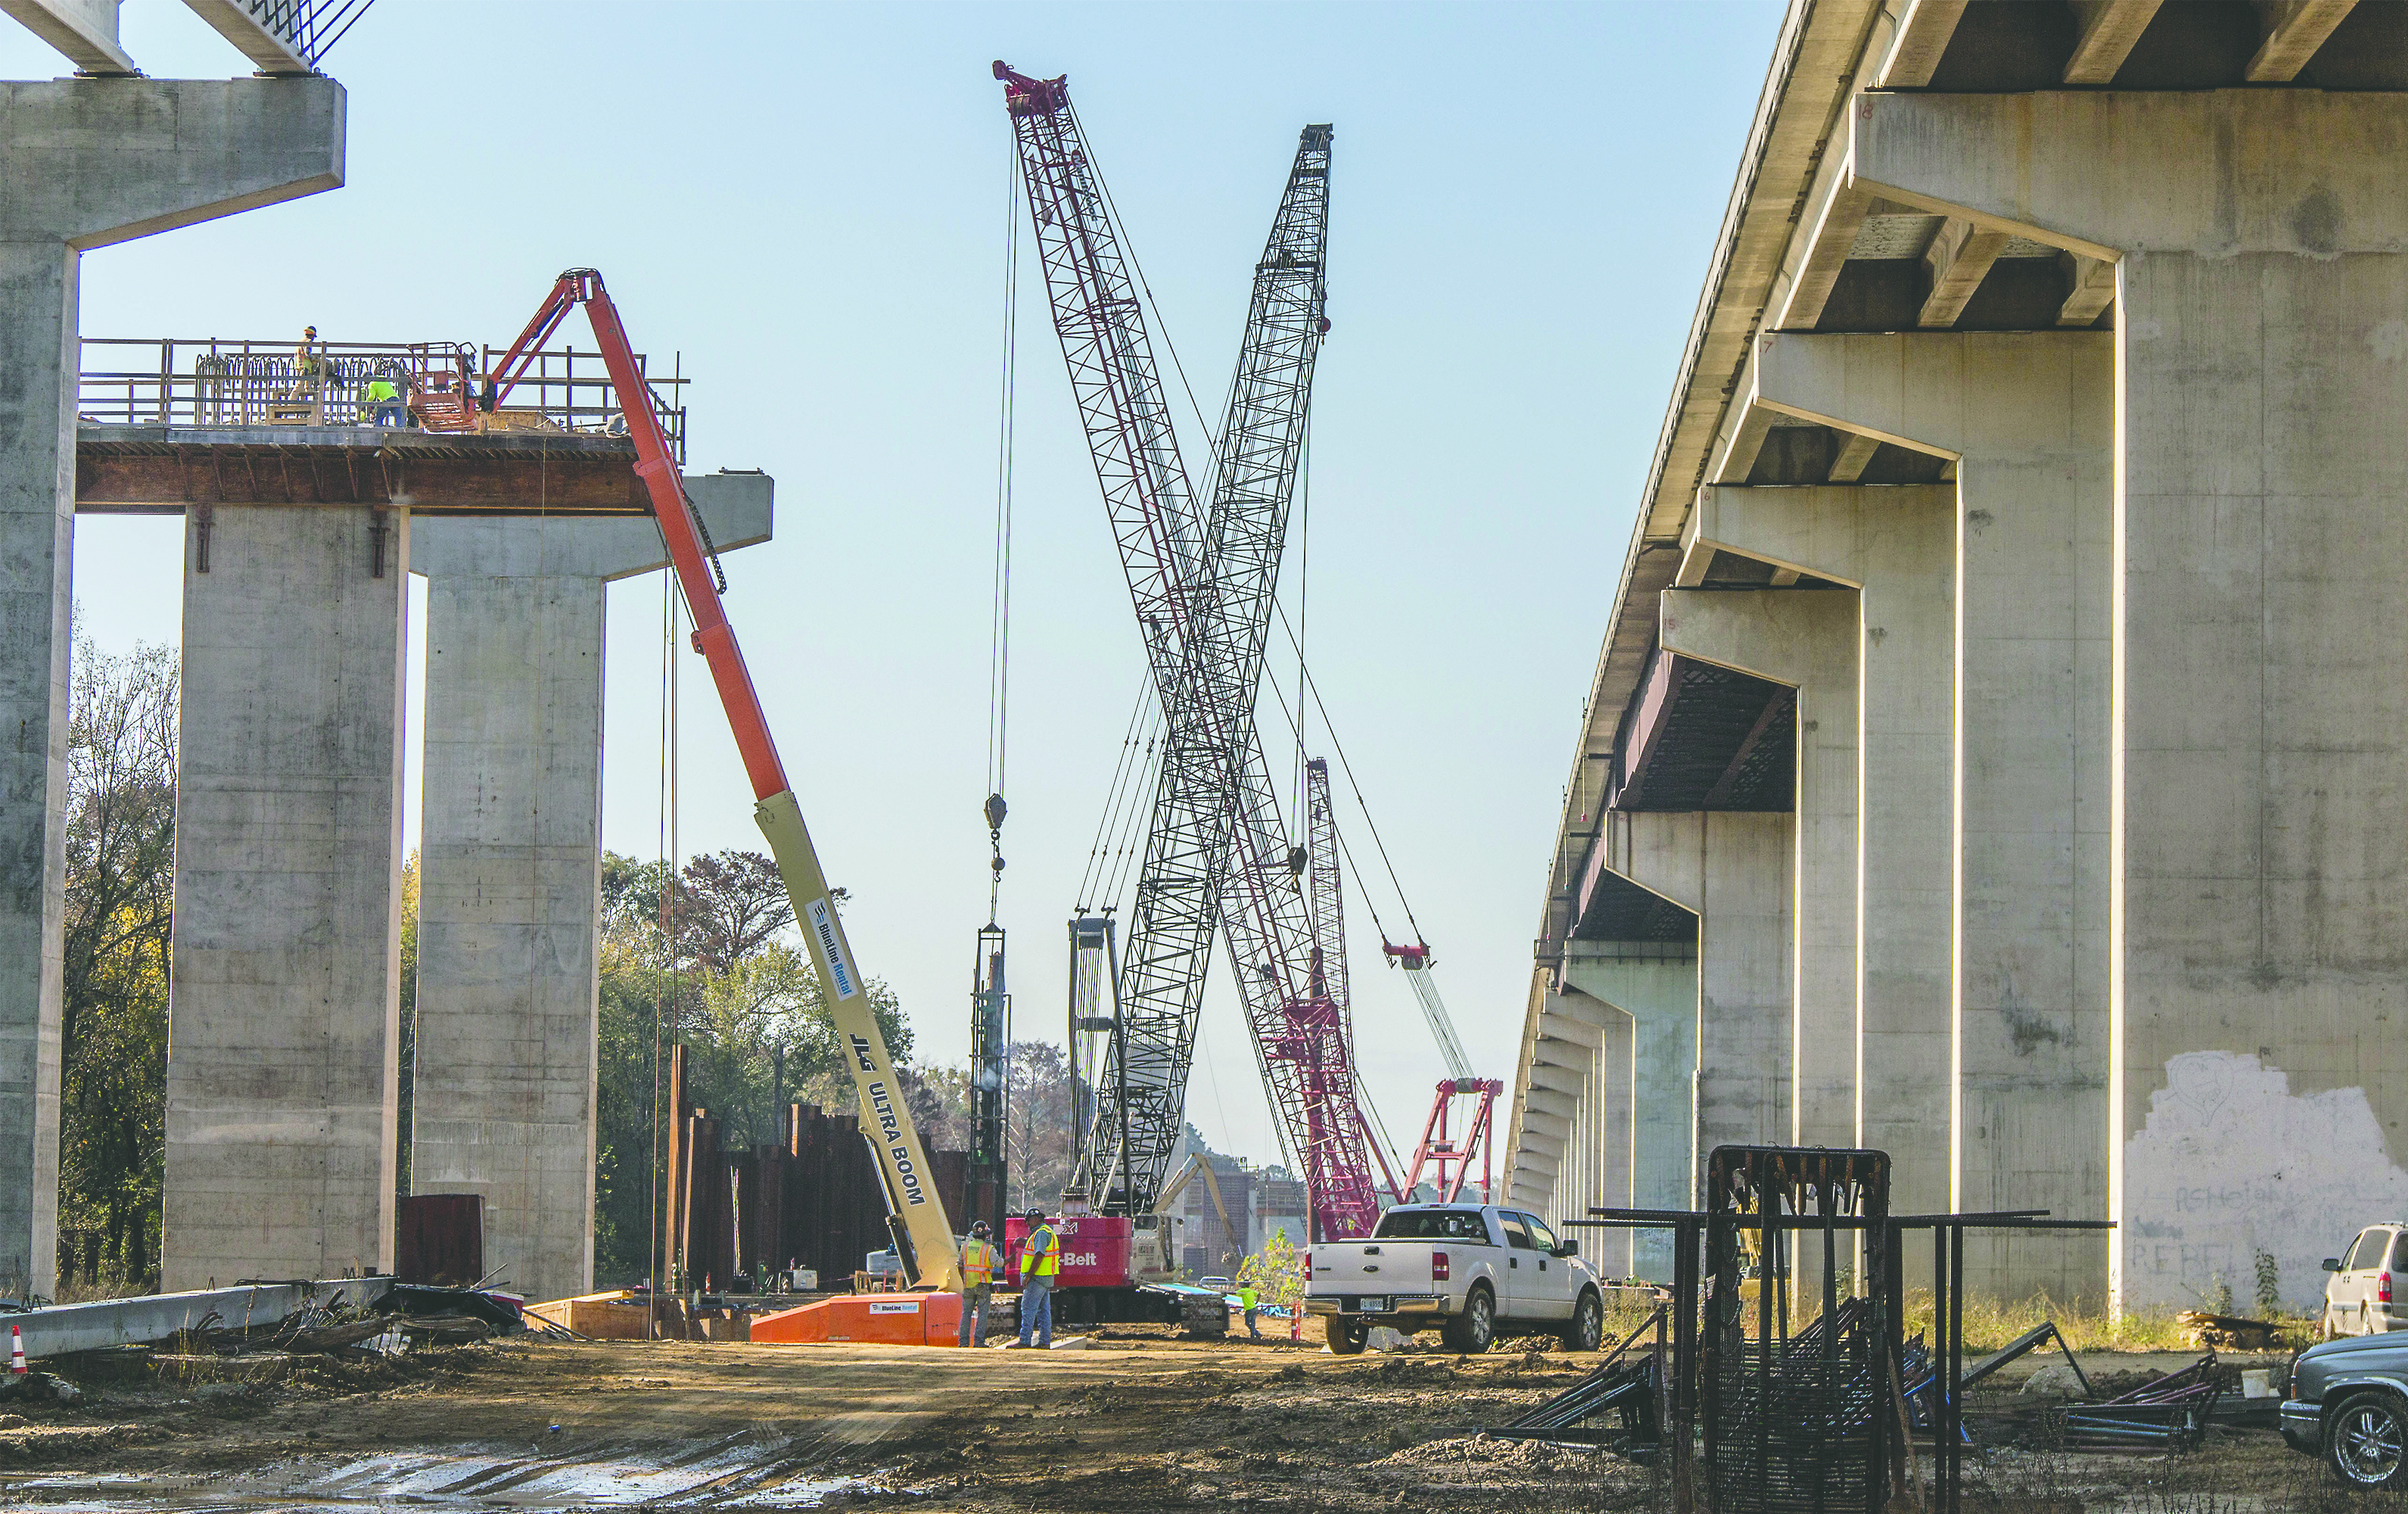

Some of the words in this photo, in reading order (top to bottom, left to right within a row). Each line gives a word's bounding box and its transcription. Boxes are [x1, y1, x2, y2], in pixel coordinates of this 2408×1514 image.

[1072, 154, 1098, 222] Manitowoc
[818, 923, 839, 964] BlueLine
[833, 963, 852, 995] Rental
[848, 1033, 878, 1073] JLG
[868, 1081, 902, 1144] ULTRA
[890, 1145, 926, 1207] BOOM
[1059, 1252, 1097, 1266] -Belt
